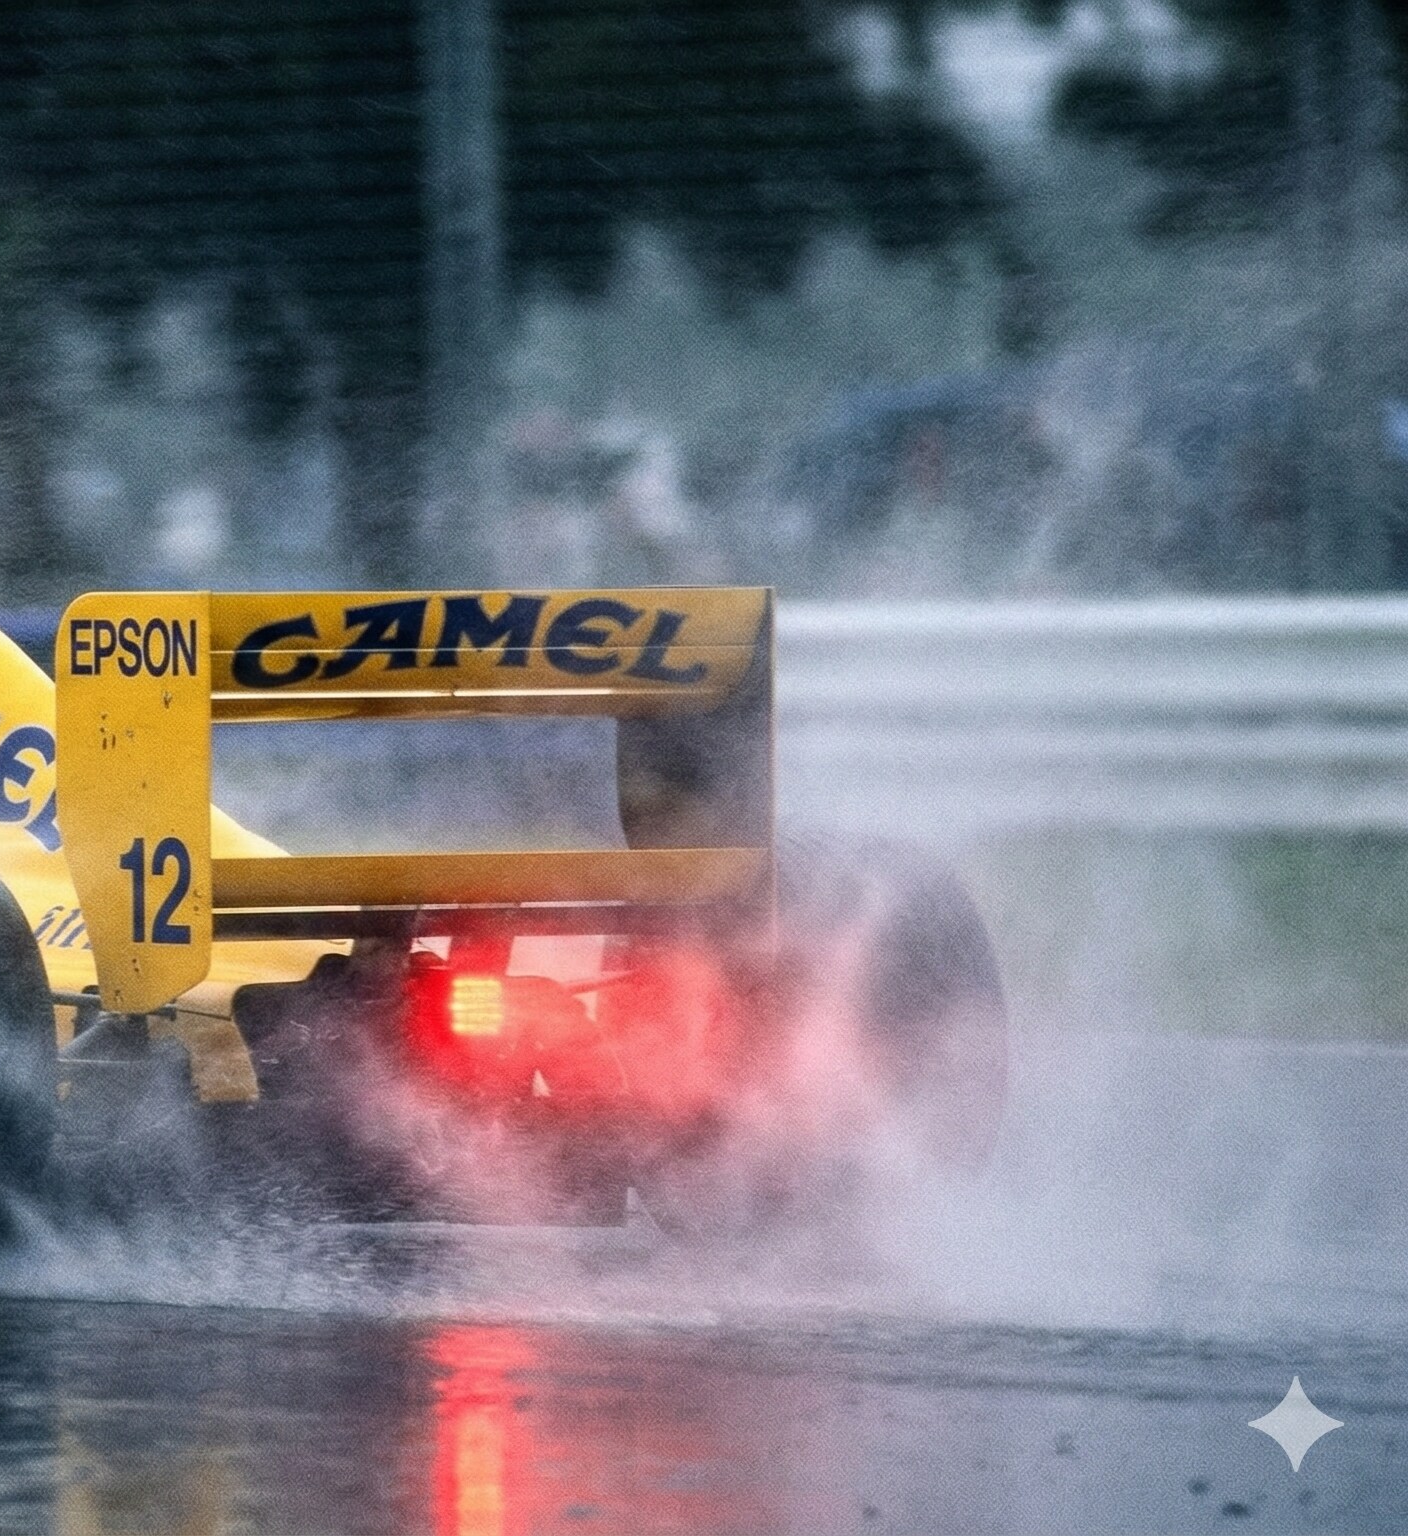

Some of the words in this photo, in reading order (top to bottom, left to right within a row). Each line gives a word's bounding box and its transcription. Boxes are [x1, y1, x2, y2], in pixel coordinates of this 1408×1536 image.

[70, 618, 197, 677] EPSON
[232, 594, 706, 688] CAMEL
[120, 837, 192, 944] 12
